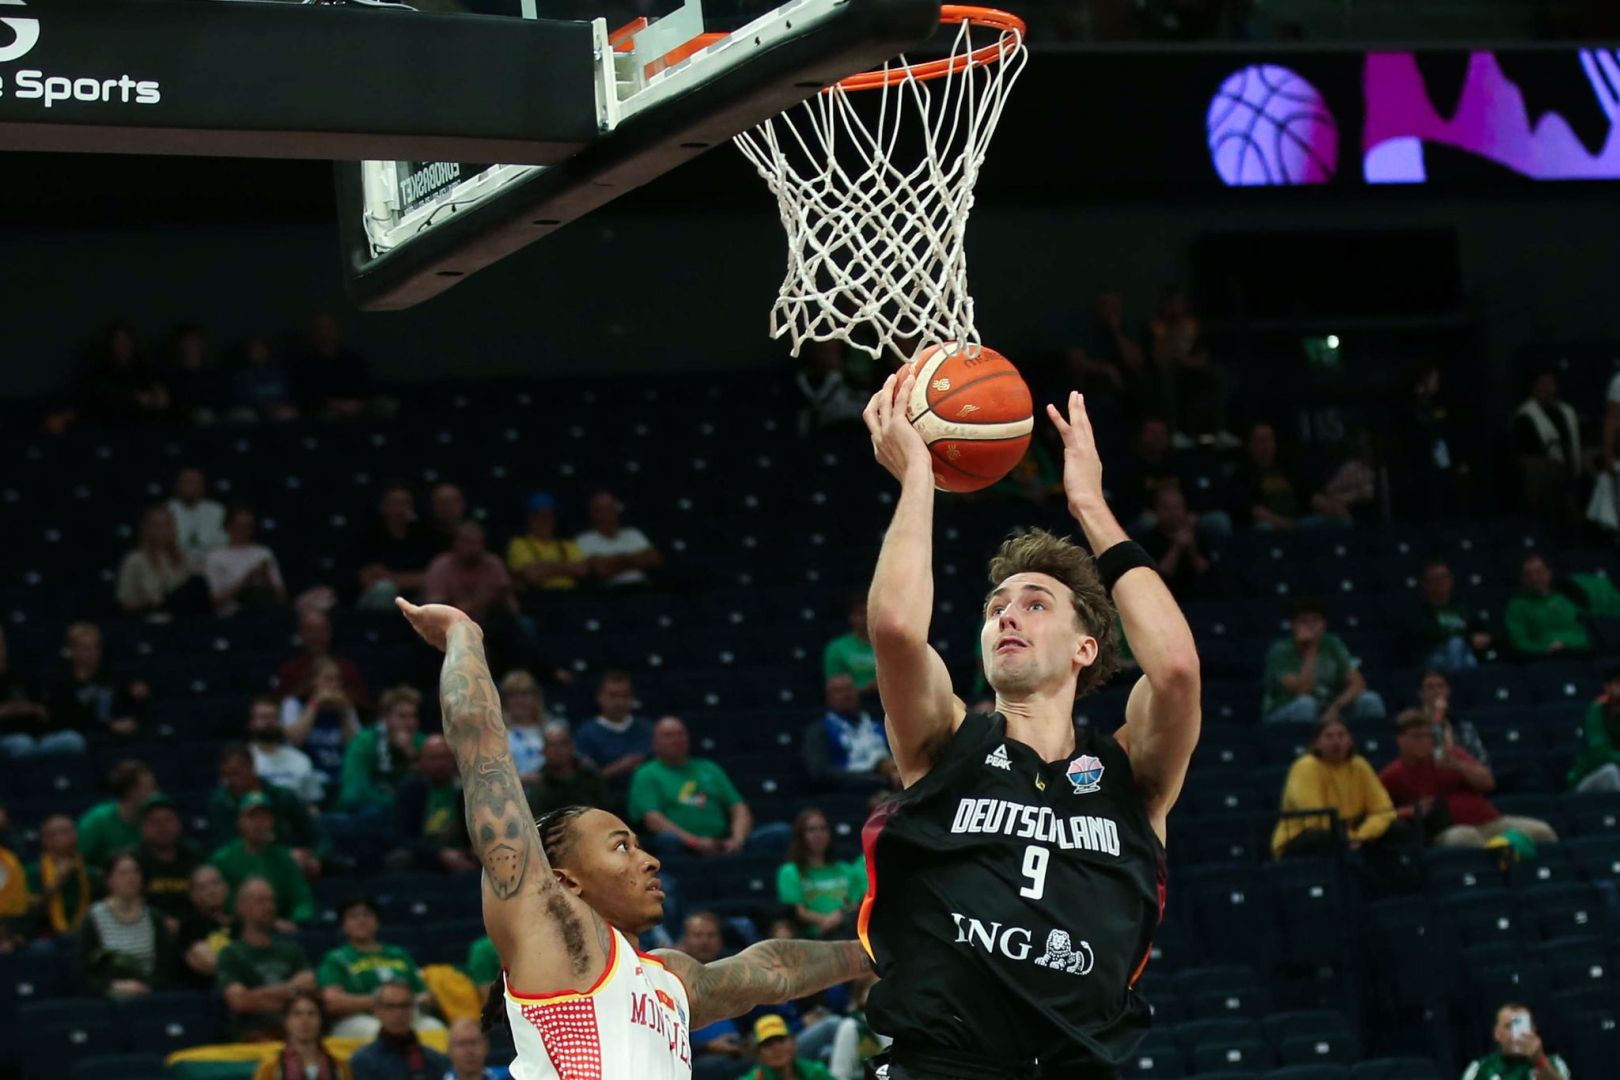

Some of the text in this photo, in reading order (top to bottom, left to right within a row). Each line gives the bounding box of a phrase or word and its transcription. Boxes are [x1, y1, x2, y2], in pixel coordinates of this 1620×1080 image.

[15, 70, 160, 108] Sports
[985, 753, 1013, 771] PEAK
[1019, 845, 1050, 900] 9
[951, 912, 1032, 960] ING
